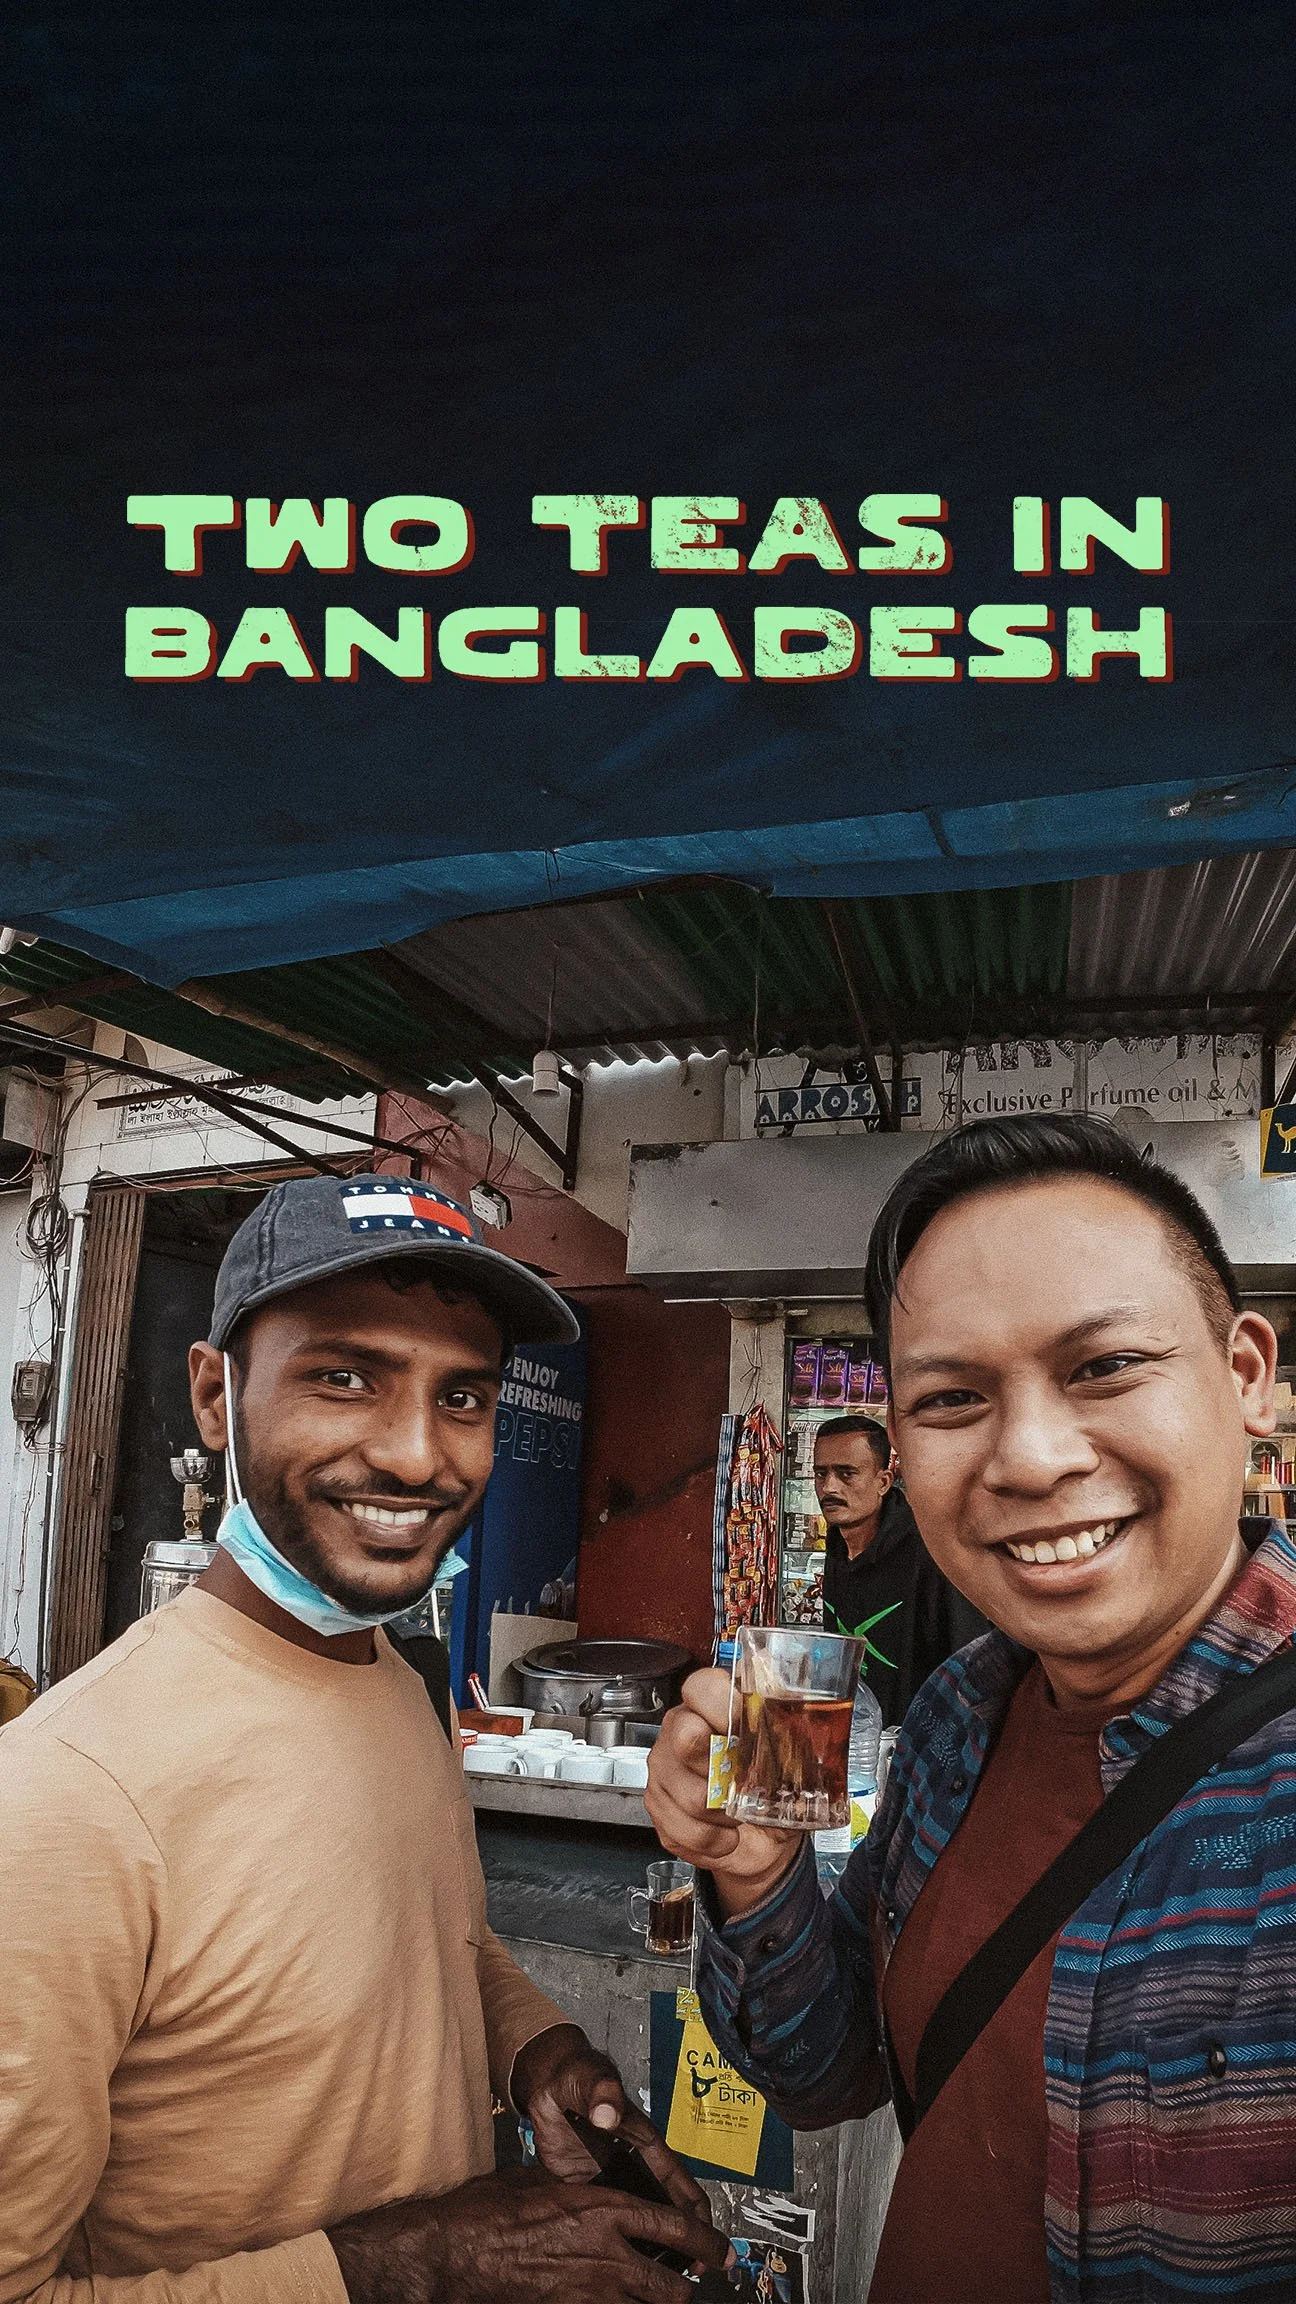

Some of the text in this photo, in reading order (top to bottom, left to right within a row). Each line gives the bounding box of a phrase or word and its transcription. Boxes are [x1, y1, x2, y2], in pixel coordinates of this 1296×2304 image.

[758, 1080, 922, 1124] ARROSH
[948, 1087, 1053, 1115] Exclusive
[1061, 1082, 1161, 1108] Prfume
[1168, 1078, 1198, 1103] oil
[1206, 1079, 1226, 1100] &
[348, 1185, 456, 1210] TOMMY
[512, 1356, 559, 1390] ENJOY
[497, 1380, 583, 1422] REFRESHING
[686, 2050, 734, 2070] CAM
[717, 2082, 758, 2108] টাকা
